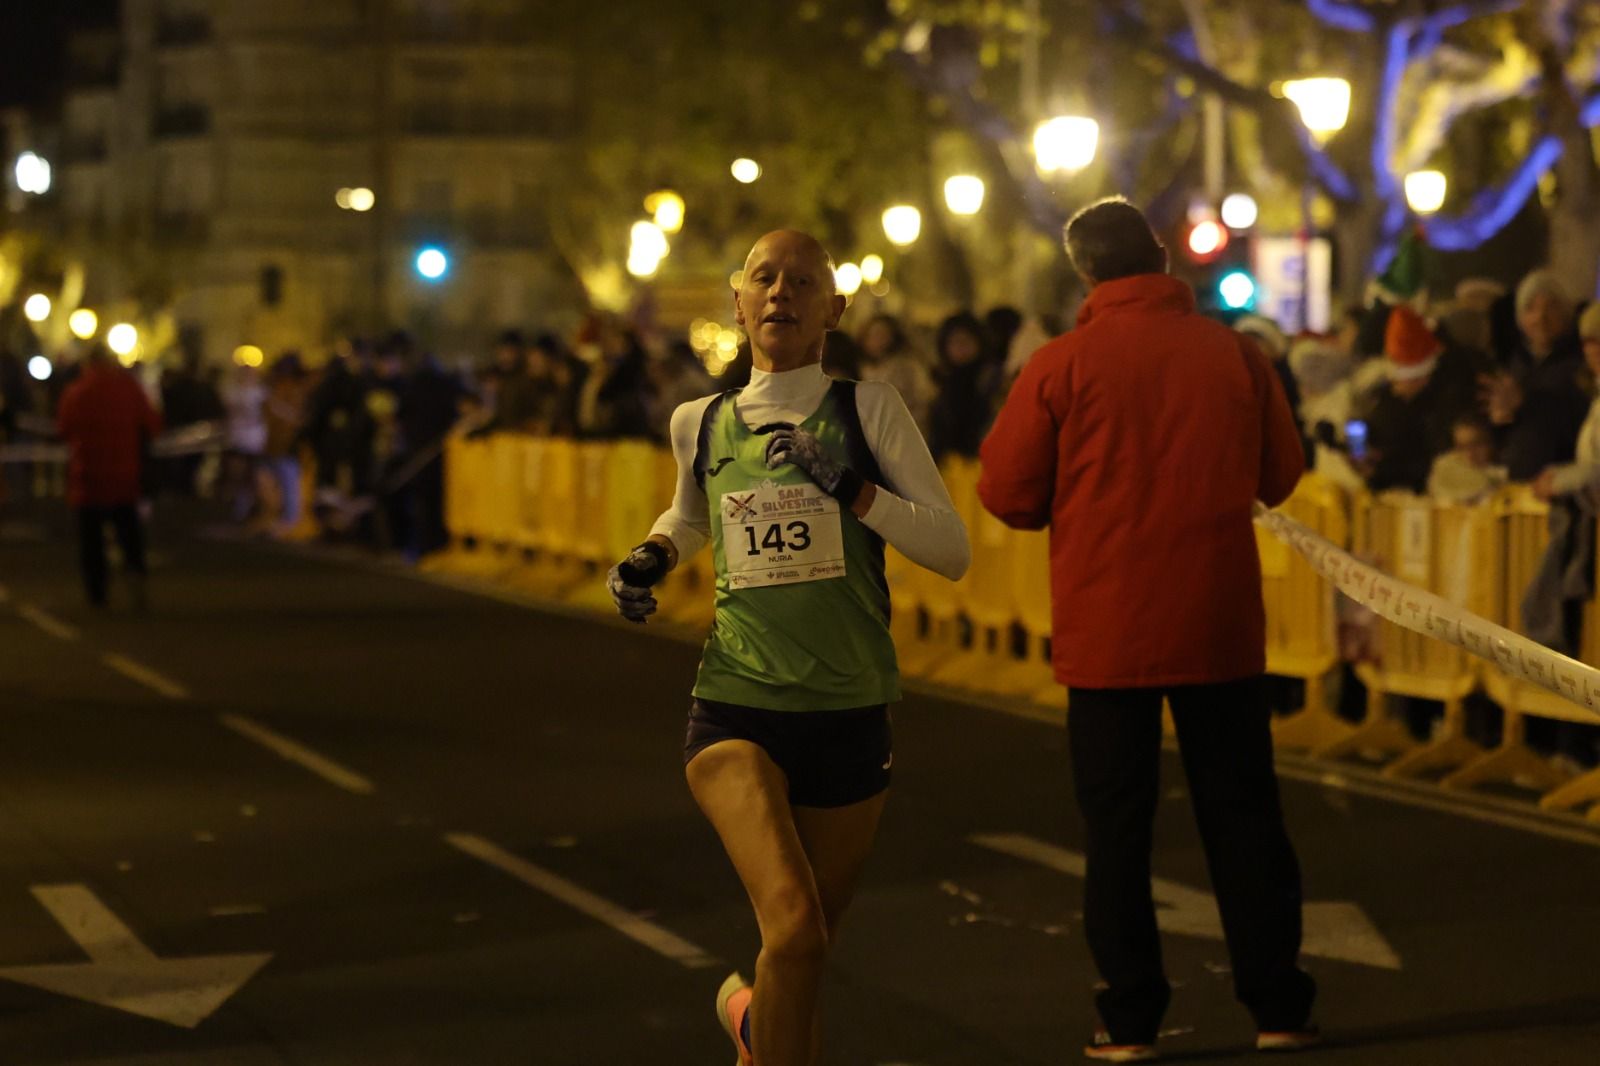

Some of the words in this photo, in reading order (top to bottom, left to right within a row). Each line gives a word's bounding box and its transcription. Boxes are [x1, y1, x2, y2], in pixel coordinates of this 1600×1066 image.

[778, 488, 804, 500] SAN
[762, 497, 824, 512] SILVESTRE
[745, 521, 811, 556] 143
[768, 555, 793, 563] NURIA
